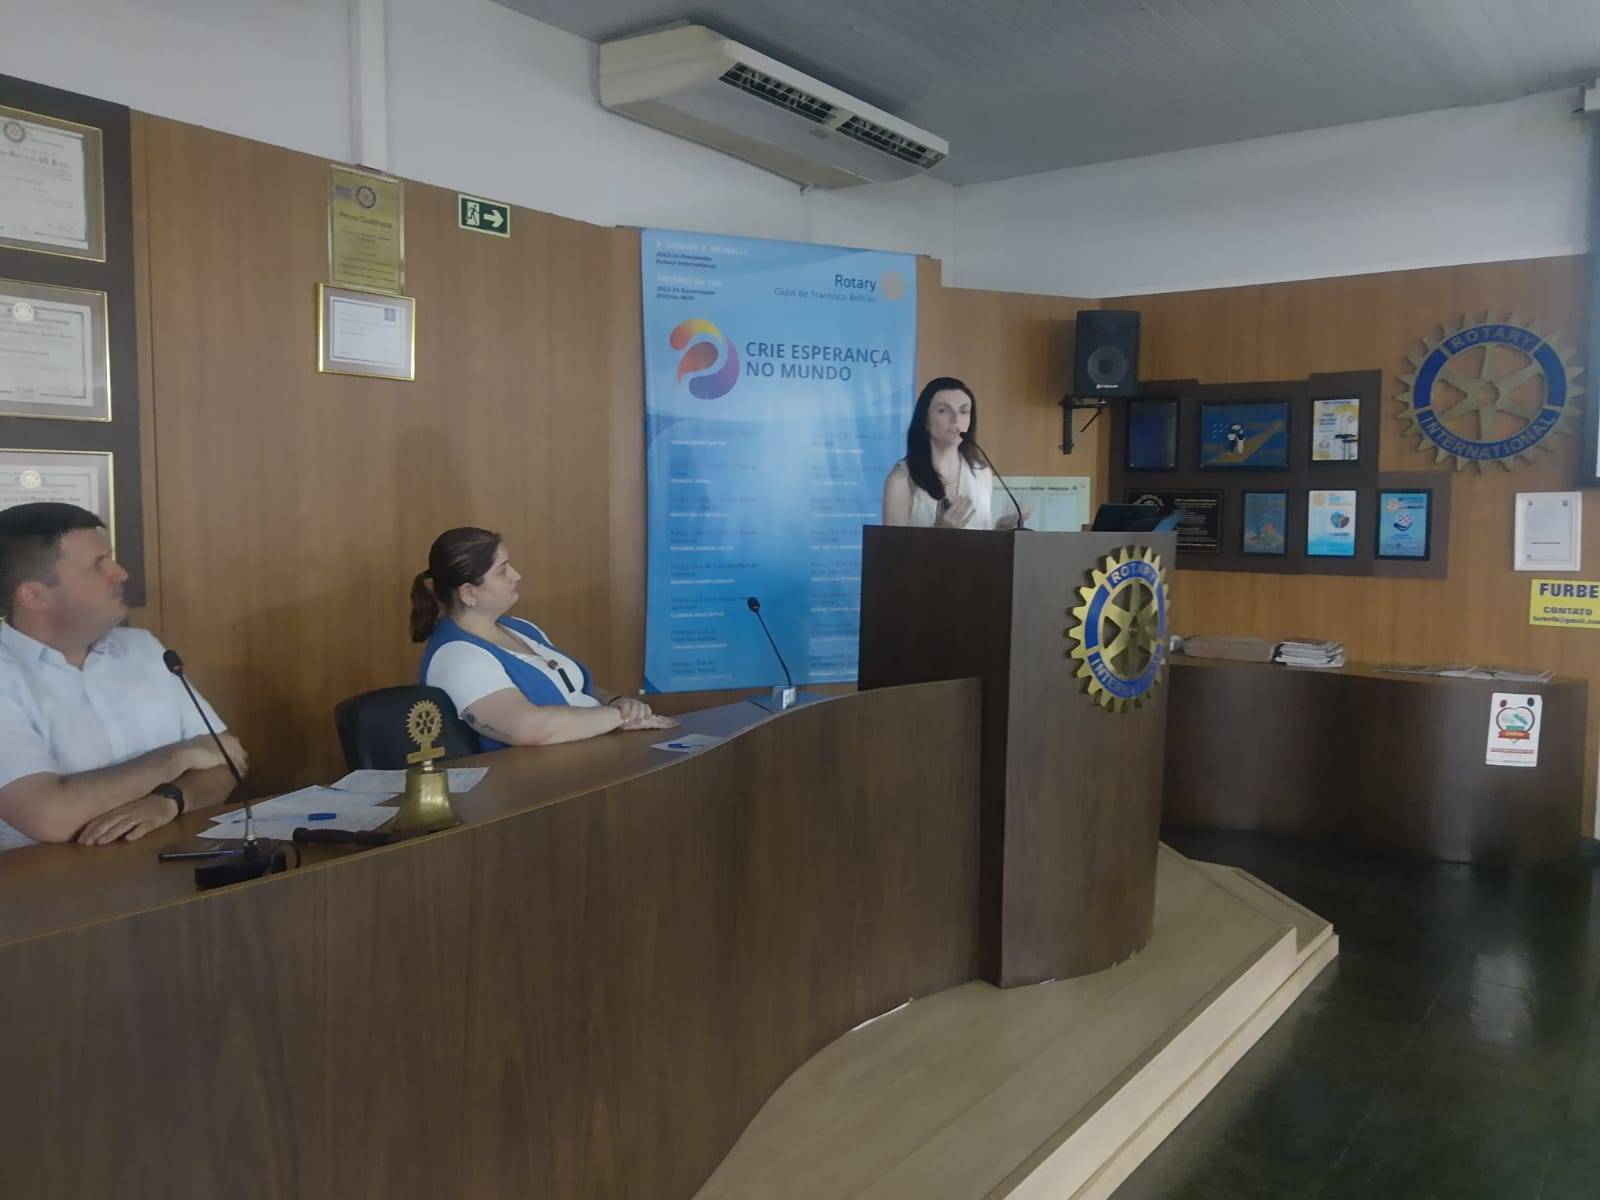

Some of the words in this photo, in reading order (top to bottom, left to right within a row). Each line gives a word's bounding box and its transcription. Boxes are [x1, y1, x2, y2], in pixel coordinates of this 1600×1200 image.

[835, 274, 877, 292] Rotary
[1450, 326, 1539, 350] ROTARY
[746, 342, 785, 359] CRIE
[791, 344, 892, 368] ESPERANÇA
[746, 361, 775, 377] NO
[780, 363, 851, 381] MUNDO
[1420, 414, 1556, 458] INTERNATIONAL
[1110, 562, 1158, 584] ROTARY
[1543, 606, 1592, 616] CONTATO
